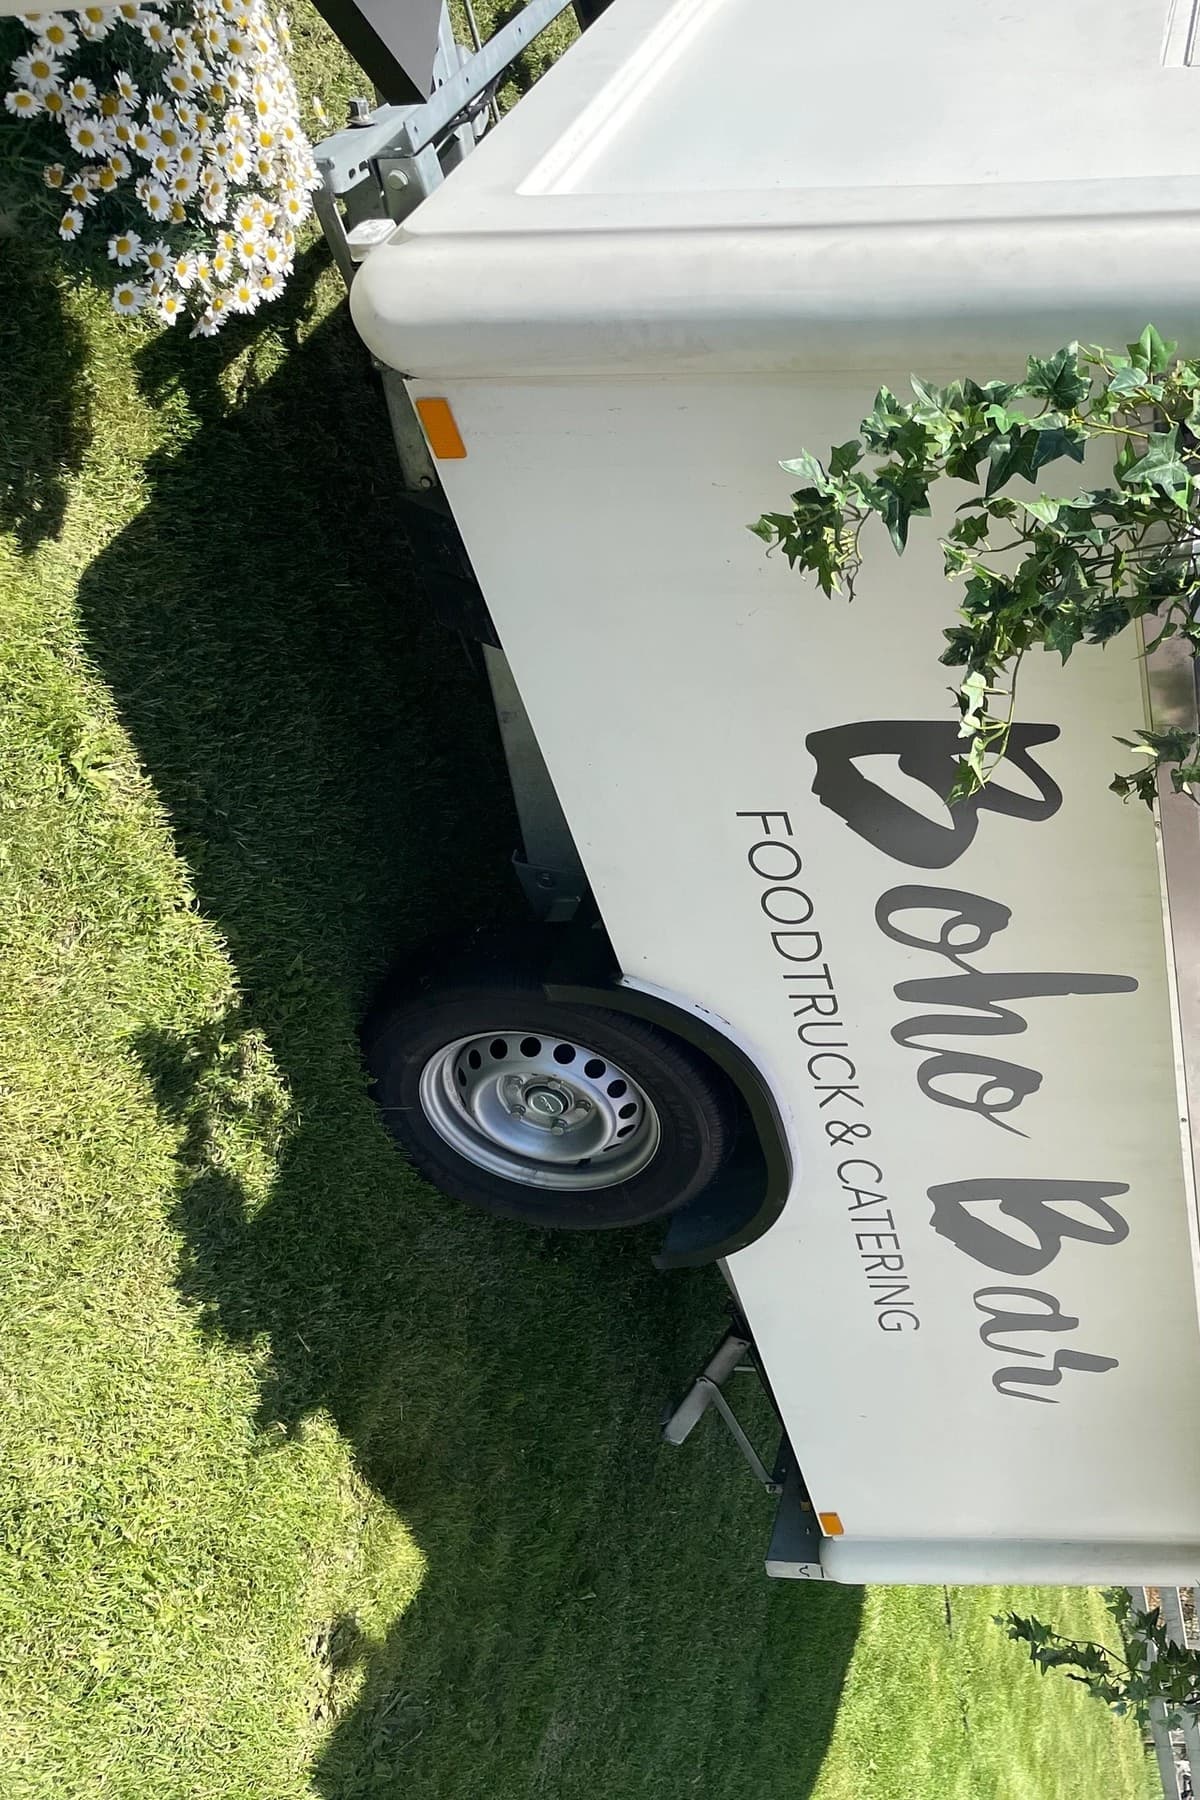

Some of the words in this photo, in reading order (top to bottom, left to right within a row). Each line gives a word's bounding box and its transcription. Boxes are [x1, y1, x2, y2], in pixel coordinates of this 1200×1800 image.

[735, 810, 864, 1109] FOODTRUCK
[805, 720, 1139, 1139] Boho
[825, 1120, 873, 1147] &
[836, 1158, 920, 1333] CATERING
[926, 1178, 1131, 1403] Bar
